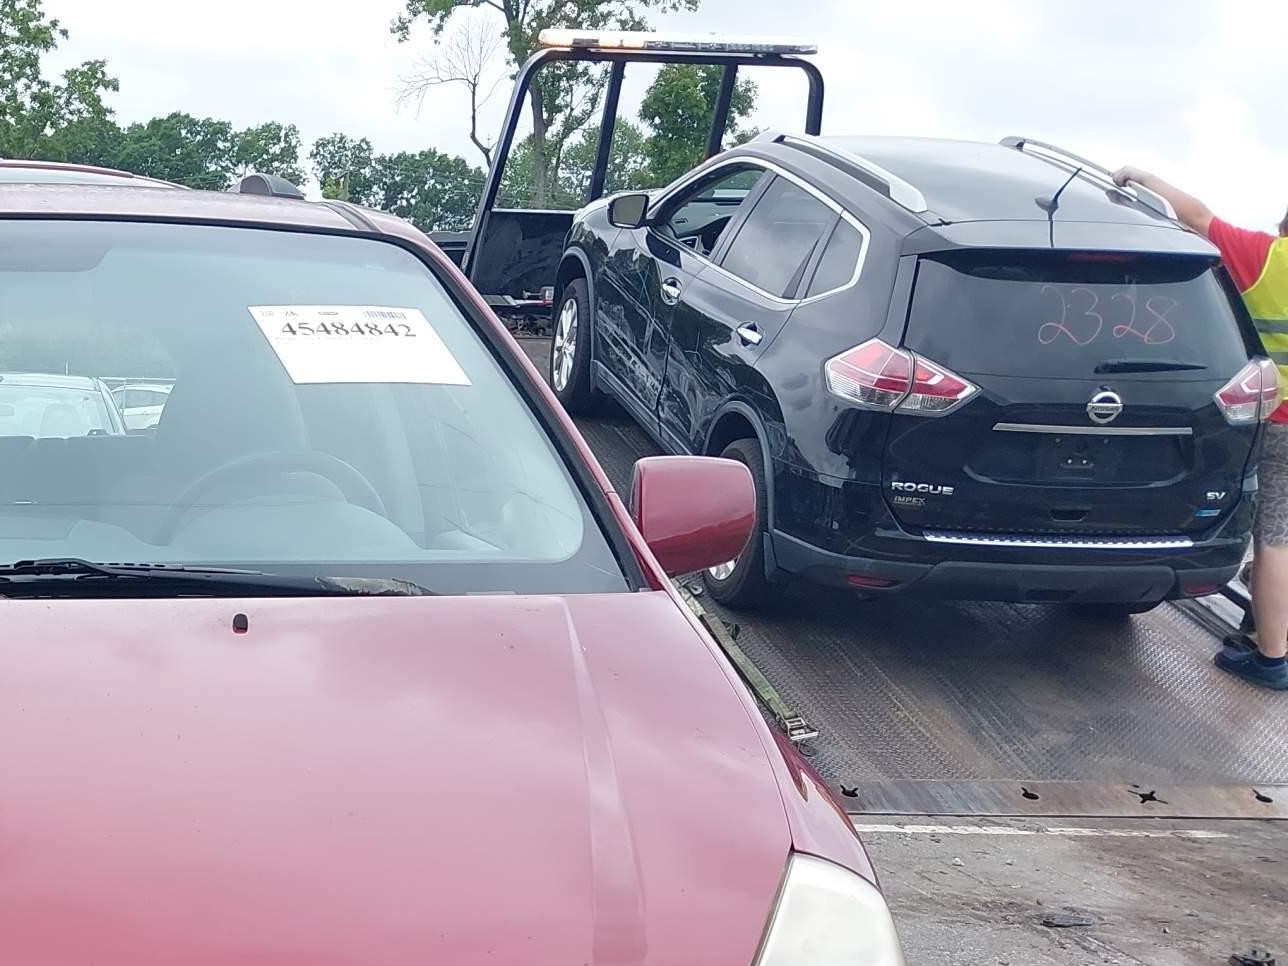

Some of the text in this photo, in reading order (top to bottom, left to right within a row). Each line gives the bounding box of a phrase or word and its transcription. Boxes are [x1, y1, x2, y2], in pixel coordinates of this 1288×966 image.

[1038, 286, 1177, 345] 2328
[281, 322, 416, 337] 45484842
[891, 482, 954, 495] ROGUE
